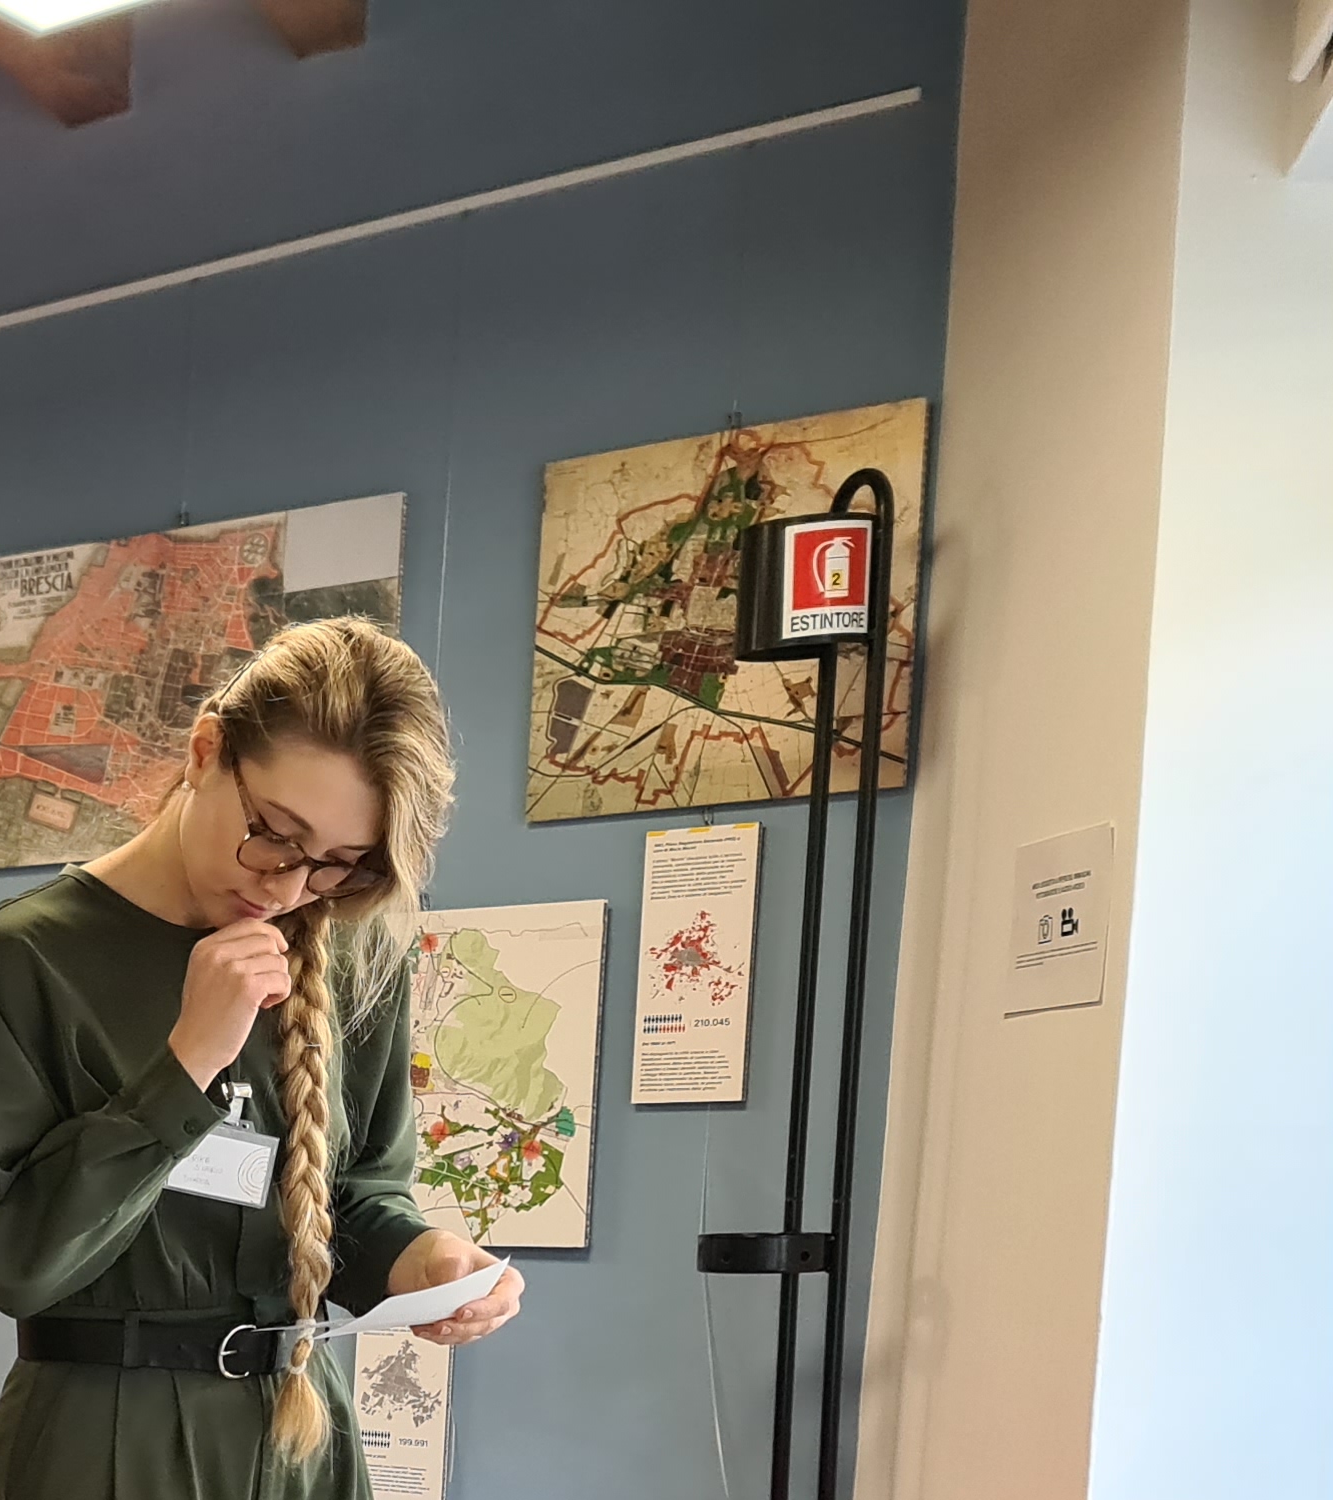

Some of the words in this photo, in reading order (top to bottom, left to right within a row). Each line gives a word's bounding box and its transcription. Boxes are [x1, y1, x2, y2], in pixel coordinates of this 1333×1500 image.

[20, 572, 74, 597] BRESCIA
[831, 572, 841, 586] 2
[790, 611, 865, 632] ESTINTORE
[693, 1018, 731, 1028] 210.045
[398, 1438, 429, 1447] 199.991
